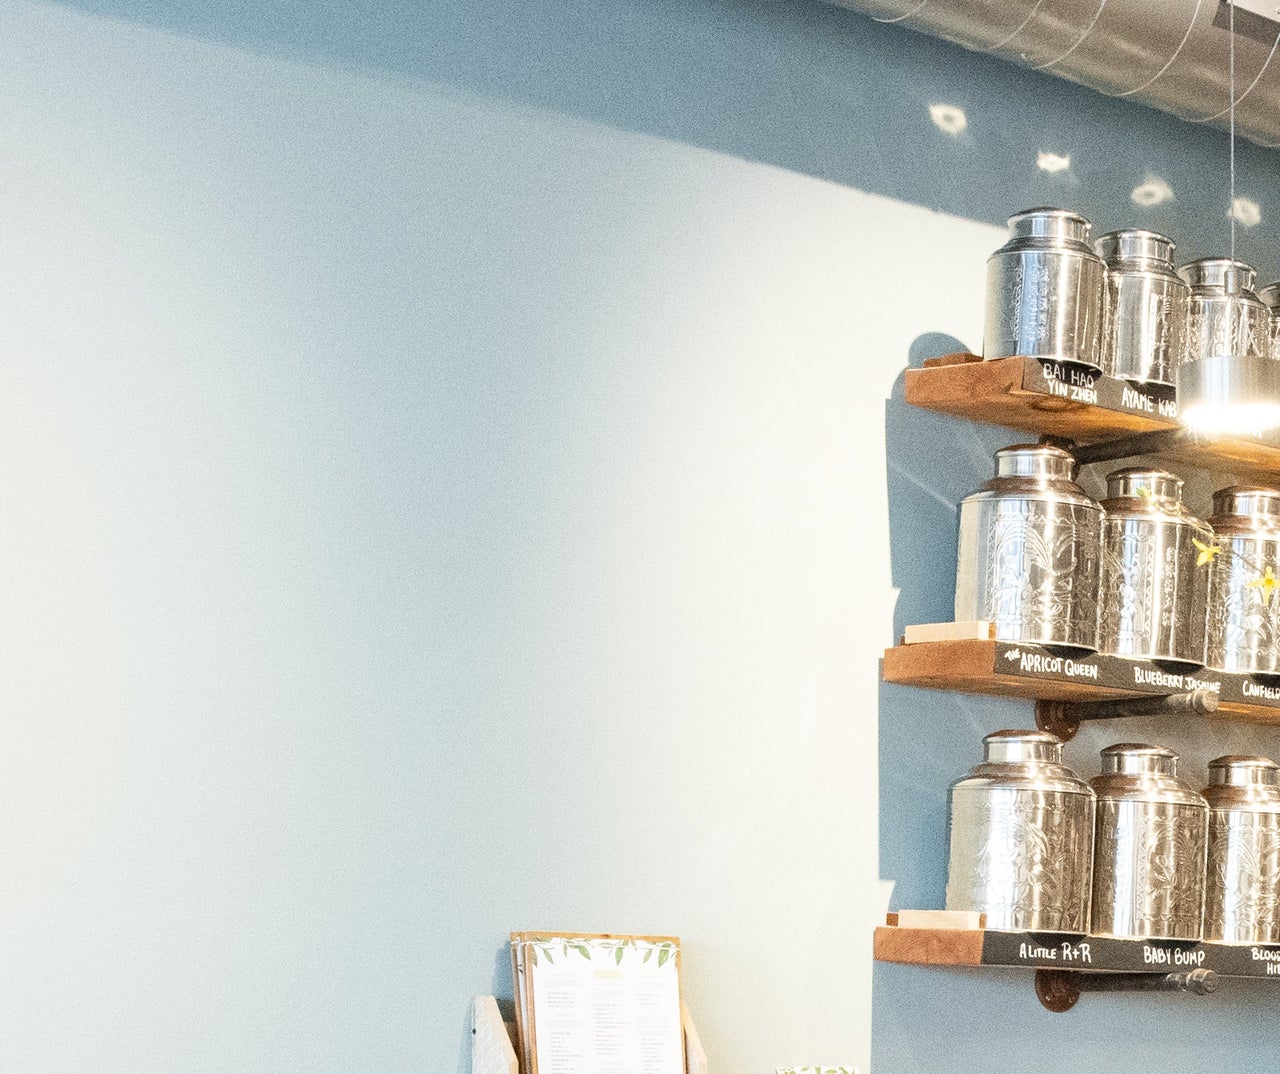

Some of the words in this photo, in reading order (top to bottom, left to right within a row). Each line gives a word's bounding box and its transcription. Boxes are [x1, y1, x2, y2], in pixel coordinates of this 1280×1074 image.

[1043, 363, 1066, 380] BAI
[1071, 370, 1094, 387] HAO
[1049, 379, 1068, 397] YIN
[1071, 384, 1097, 404] ZHEN
[1158, 398, 1178, 418] KAB
[1020, 652, 1063, 673] APRICOT
[1065, 659, 1098, 679] QUEEN
[1134, 667, 1183, 689] BLUEBERRY
[1185, 676, 1221, 694] JASMINE
[1243, 680, 1280, 700] CANFIELD
[1019, 943, 1028, 959] A
[1028, 946, 1057, 960] LITTLE
[1062, 943, 1092, 963] R+R
[1143, 946, 1171, 964] BABY
[1174, 950, 1205, 966] BUMP
